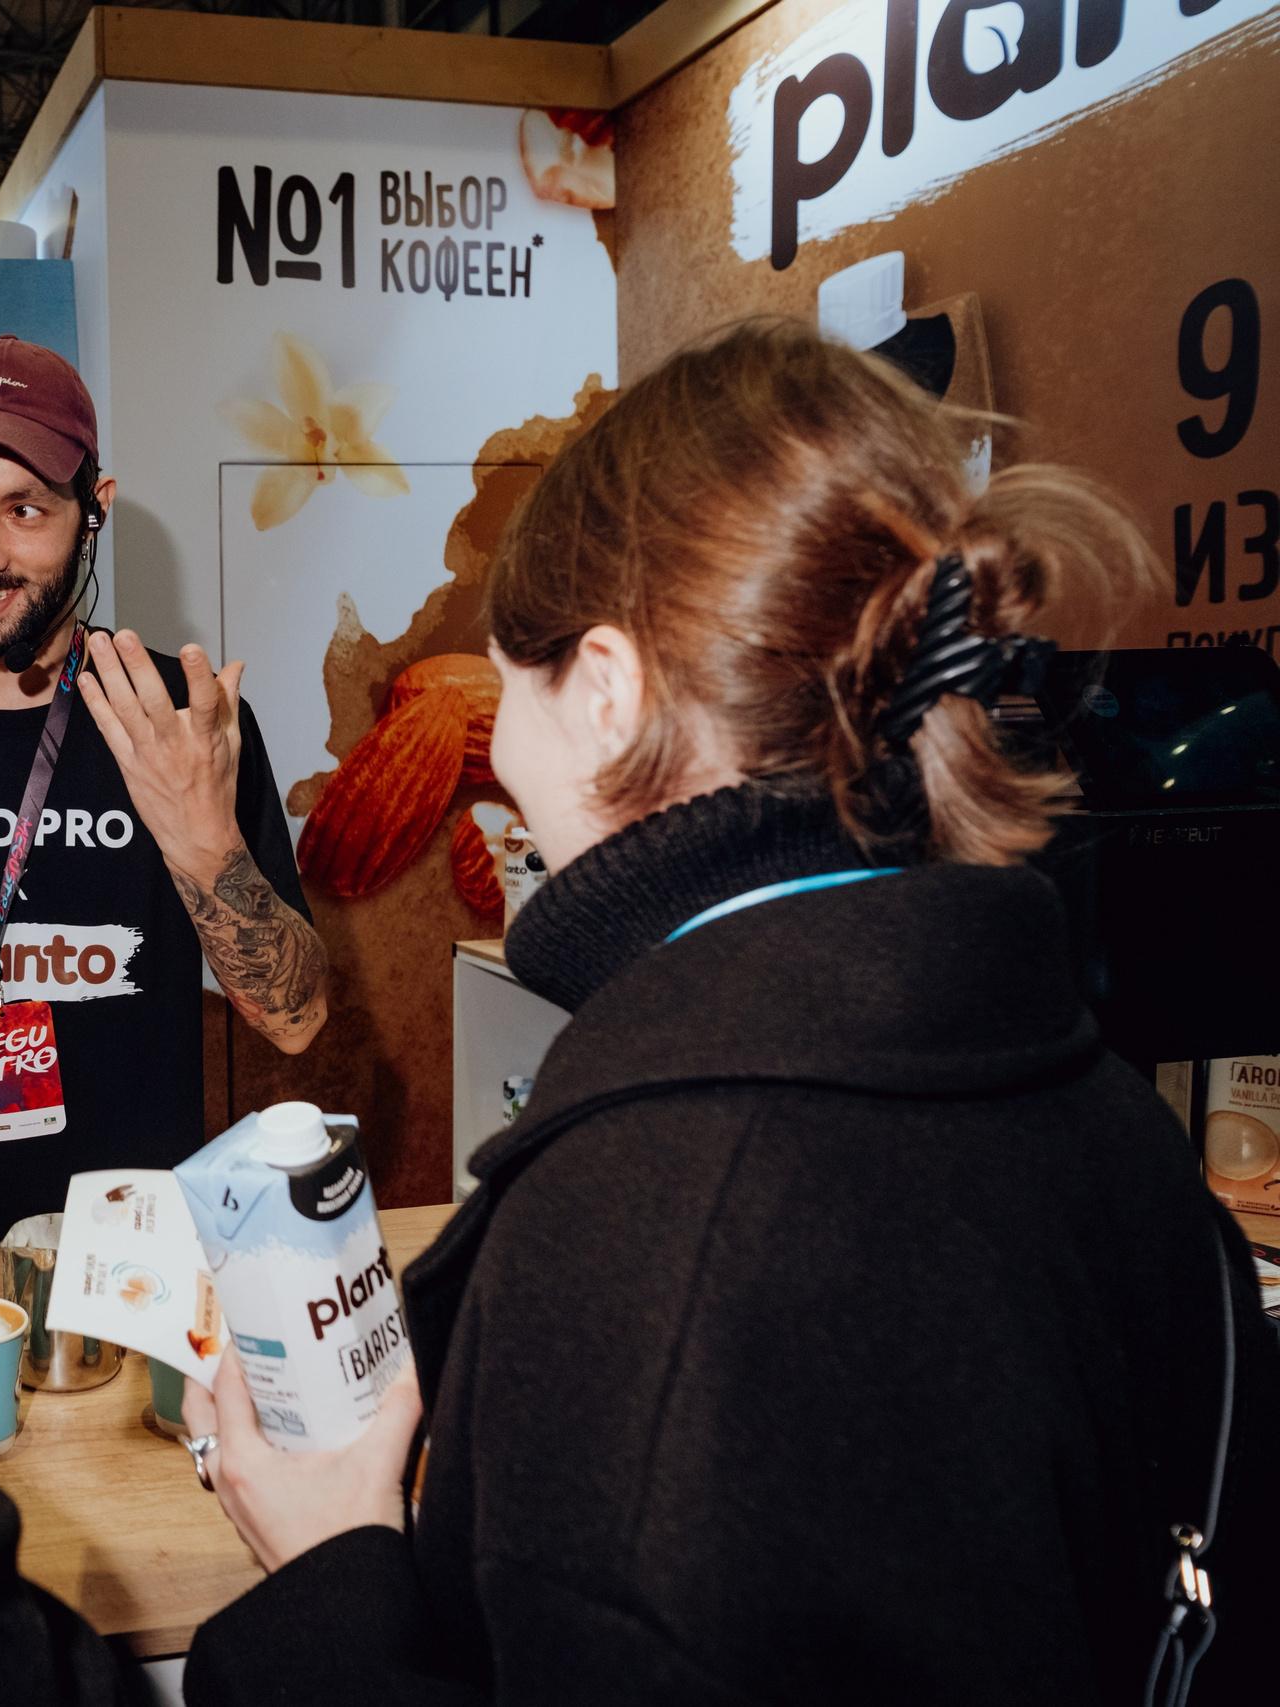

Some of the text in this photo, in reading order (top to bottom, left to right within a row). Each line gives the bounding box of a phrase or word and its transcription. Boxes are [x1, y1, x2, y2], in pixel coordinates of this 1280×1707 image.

[380, 170, 507, 230] ВЫБОР
[1177, 278, 1260, 459] 9
[34, 808, 134, 849] PRO
[1231, 1087, 1268, 1102] VANILLA
[1237, 1065, 1280, 1087] ARO
